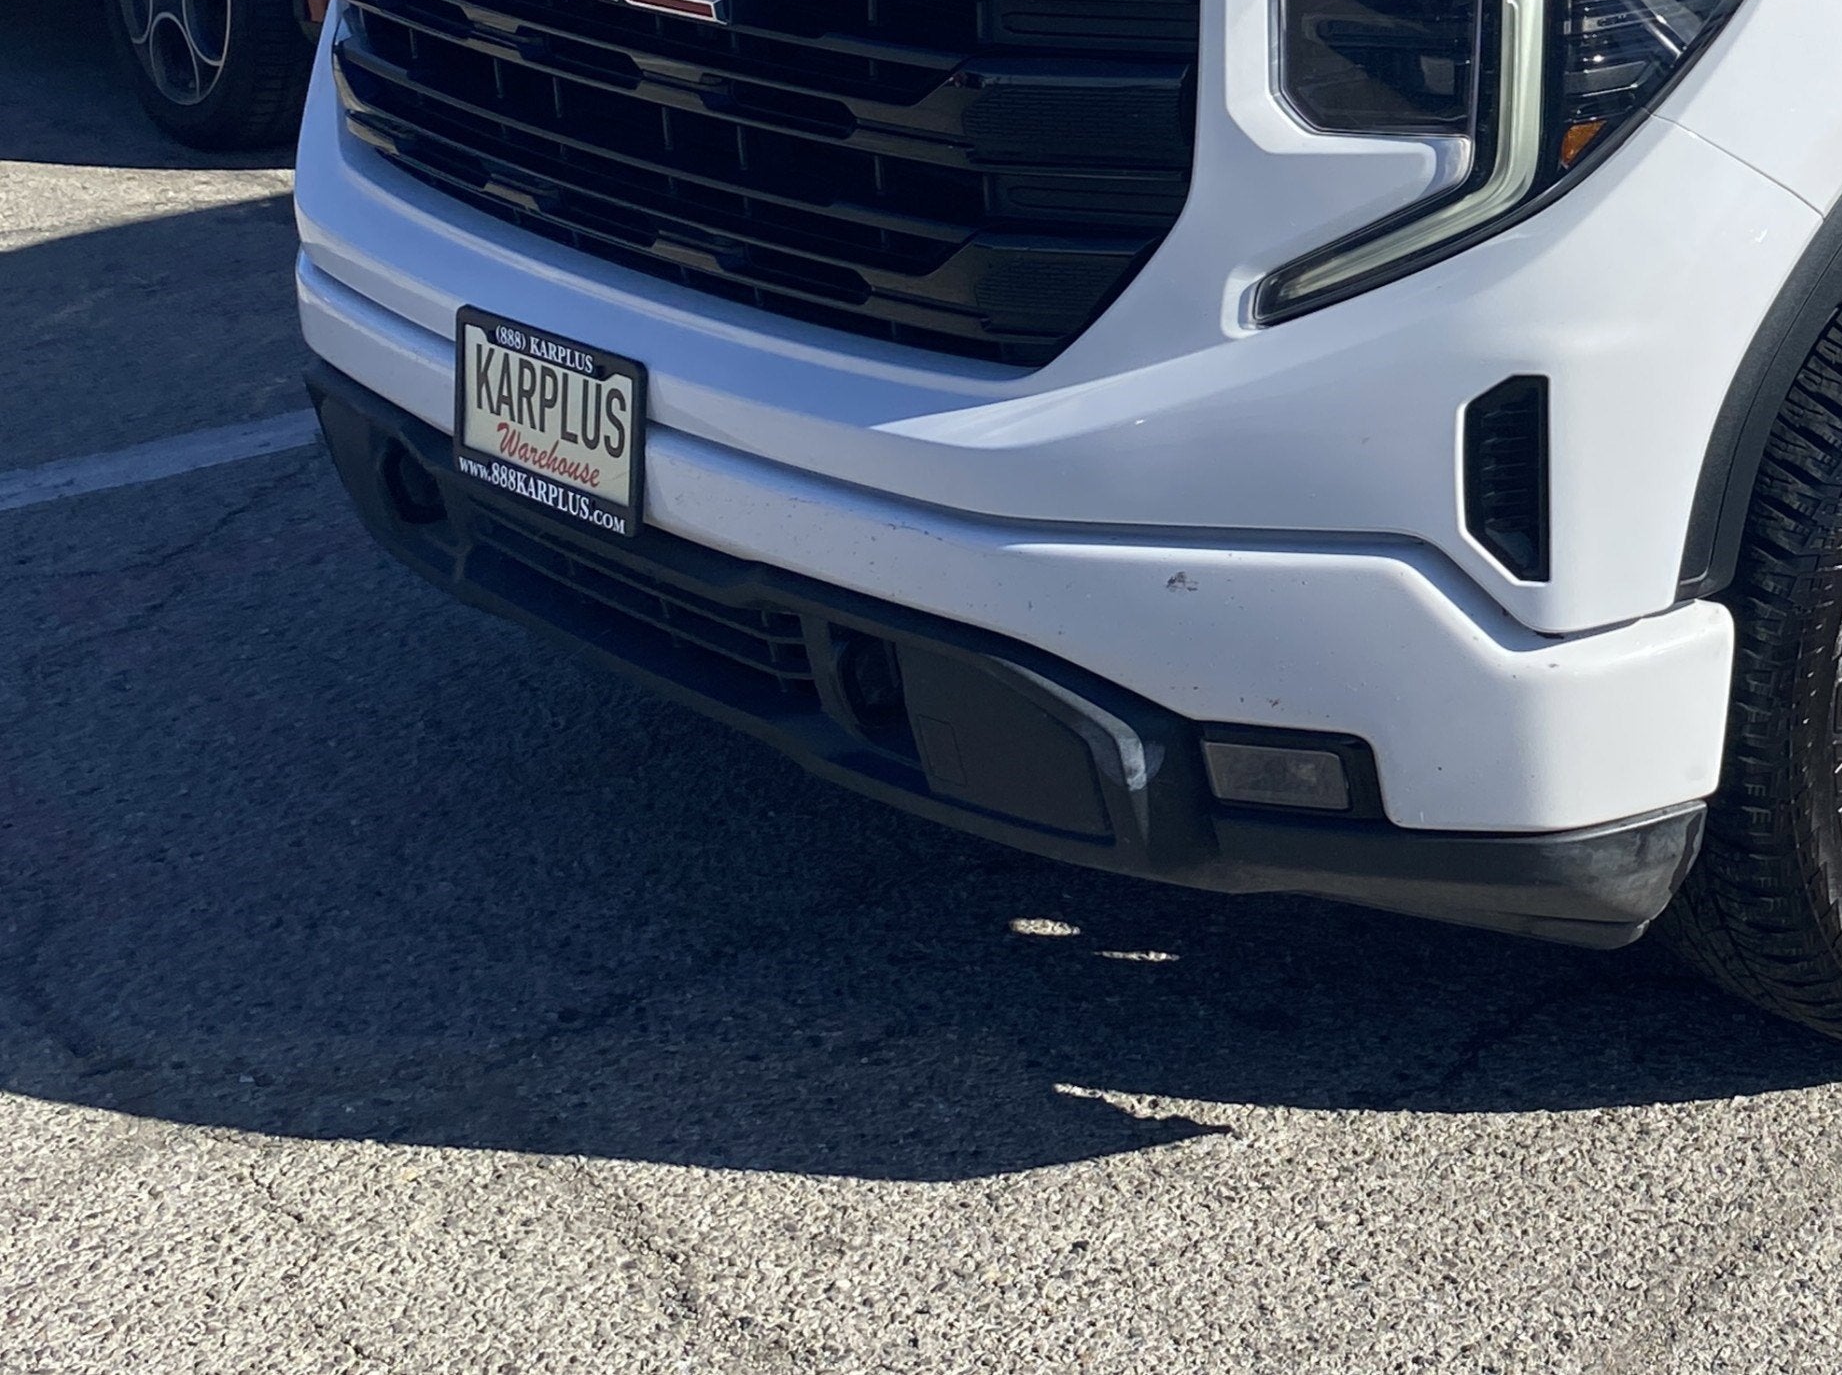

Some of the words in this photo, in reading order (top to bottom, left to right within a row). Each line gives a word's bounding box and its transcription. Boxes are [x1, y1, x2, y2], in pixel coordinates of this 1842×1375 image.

[495, 325, 526, 350] (888)
[530, 336, 594, 374] KARPLUS
[476, 343, 627, 459] KARPLUS
[497, 422, 601, 488] Warehouse
